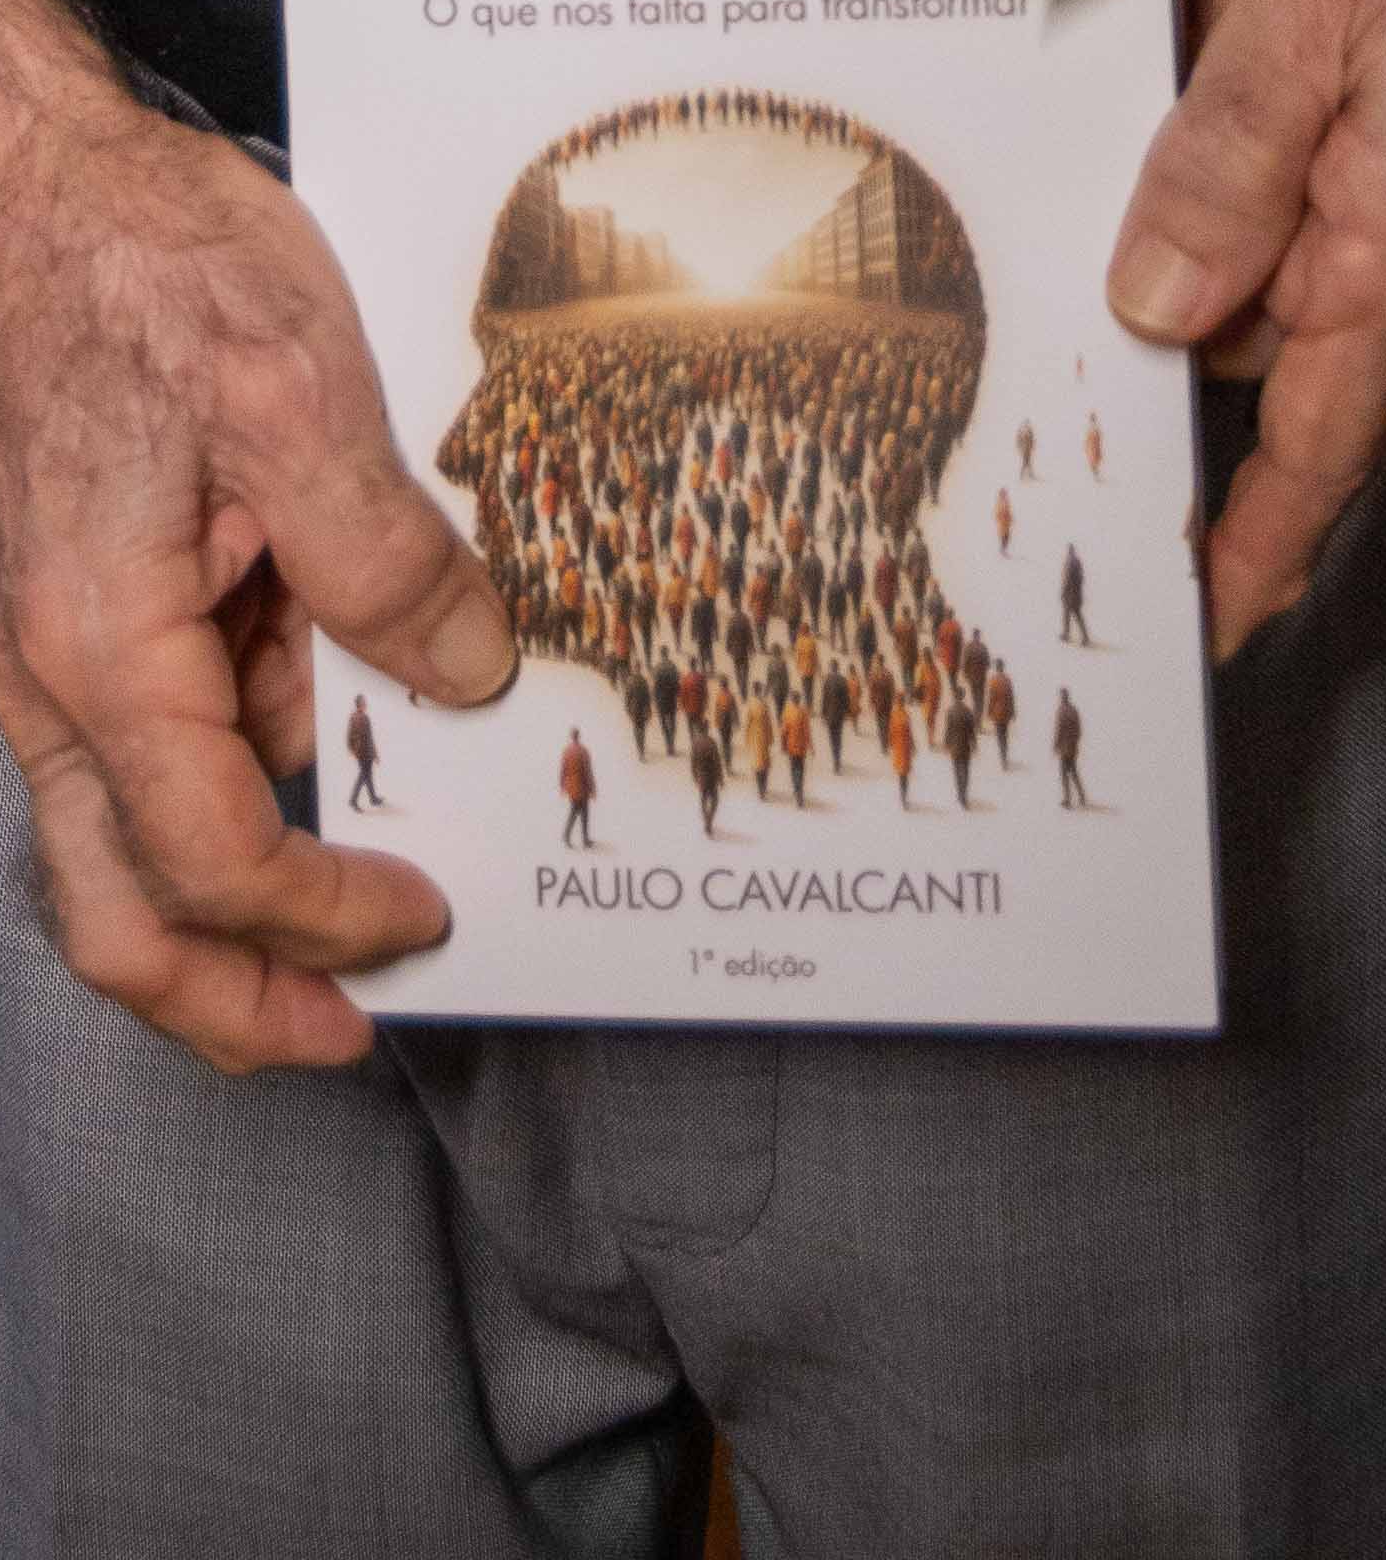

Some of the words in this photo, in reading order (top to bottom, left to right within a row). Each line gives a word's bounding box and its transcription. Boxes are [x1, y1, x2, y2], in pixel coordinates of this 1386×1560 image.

[470, 2, 539, 37] que
[551, 1, 614, 27] nos
[534, 865, 684, 912] PAULO
[699, 867, 1003, 916] CAVALCANTI
[724, 945, 817, 984] edição
